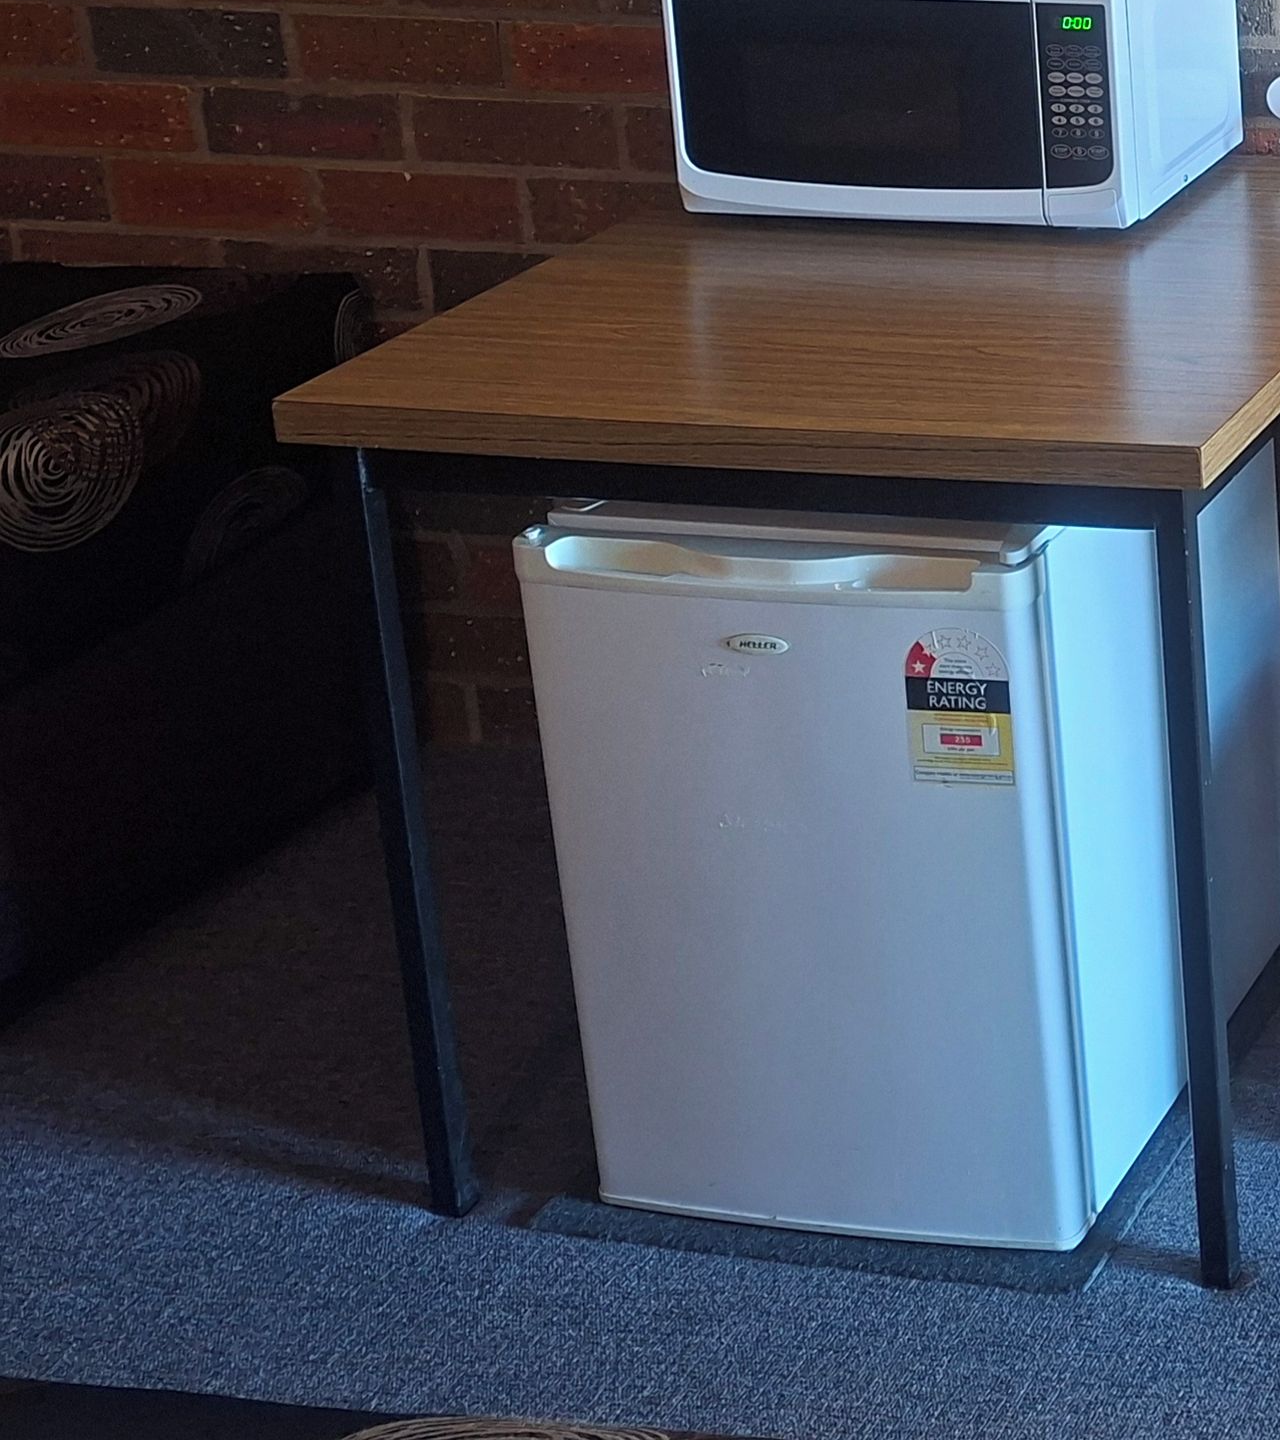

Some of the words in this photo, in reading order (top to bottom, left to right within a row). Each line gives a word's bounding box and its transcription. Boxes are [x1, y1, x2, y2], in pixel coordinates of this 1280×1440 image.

[1061, 16, 1092, 30] 0:00
[739, 640, 777, 650] HELLER
[927, 681, 987, 695] ENERGY
[929, 696, 987, 710] RATING
